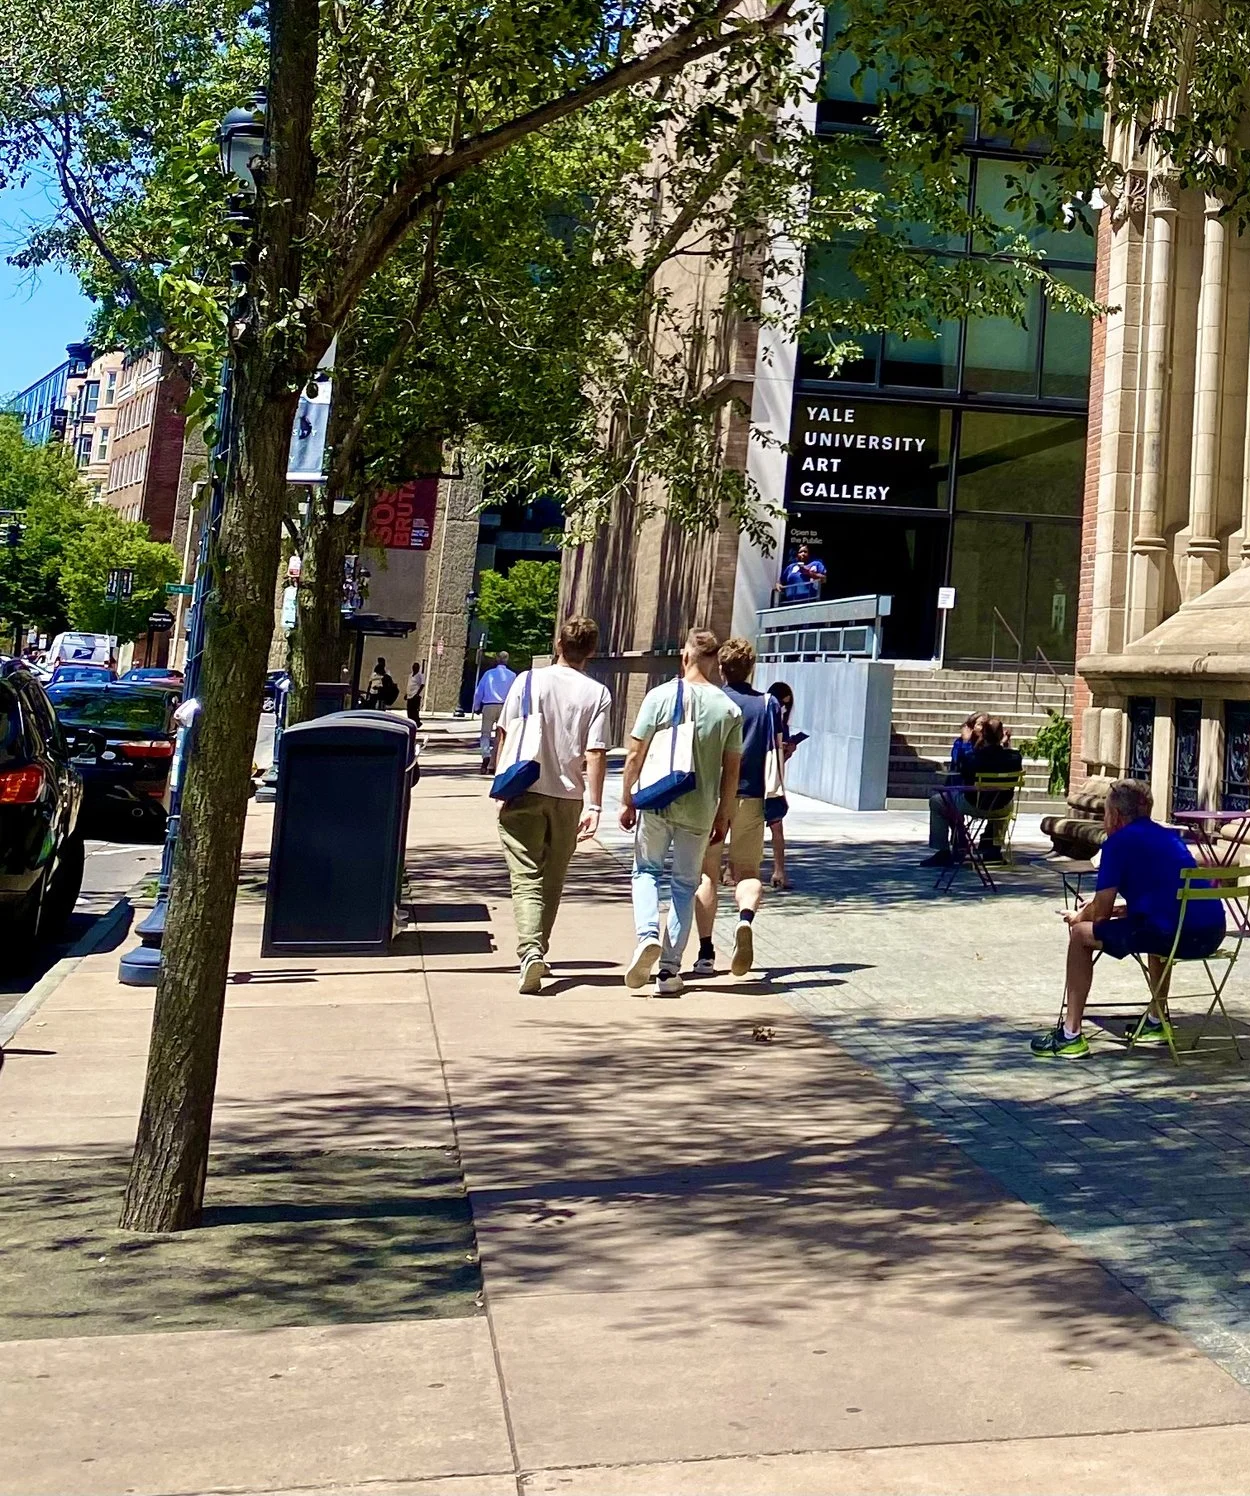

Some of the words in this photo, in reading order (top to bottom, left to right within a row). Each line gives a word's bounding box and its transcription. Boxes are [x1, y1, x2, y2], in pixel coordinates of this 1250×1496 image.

[807, 406, 855, 423] YALE
[804, 431, 926, 452] UNIVERSITY
[801, 457, 841, 472] ART
[800, 482, 890, 500] GALLERY
